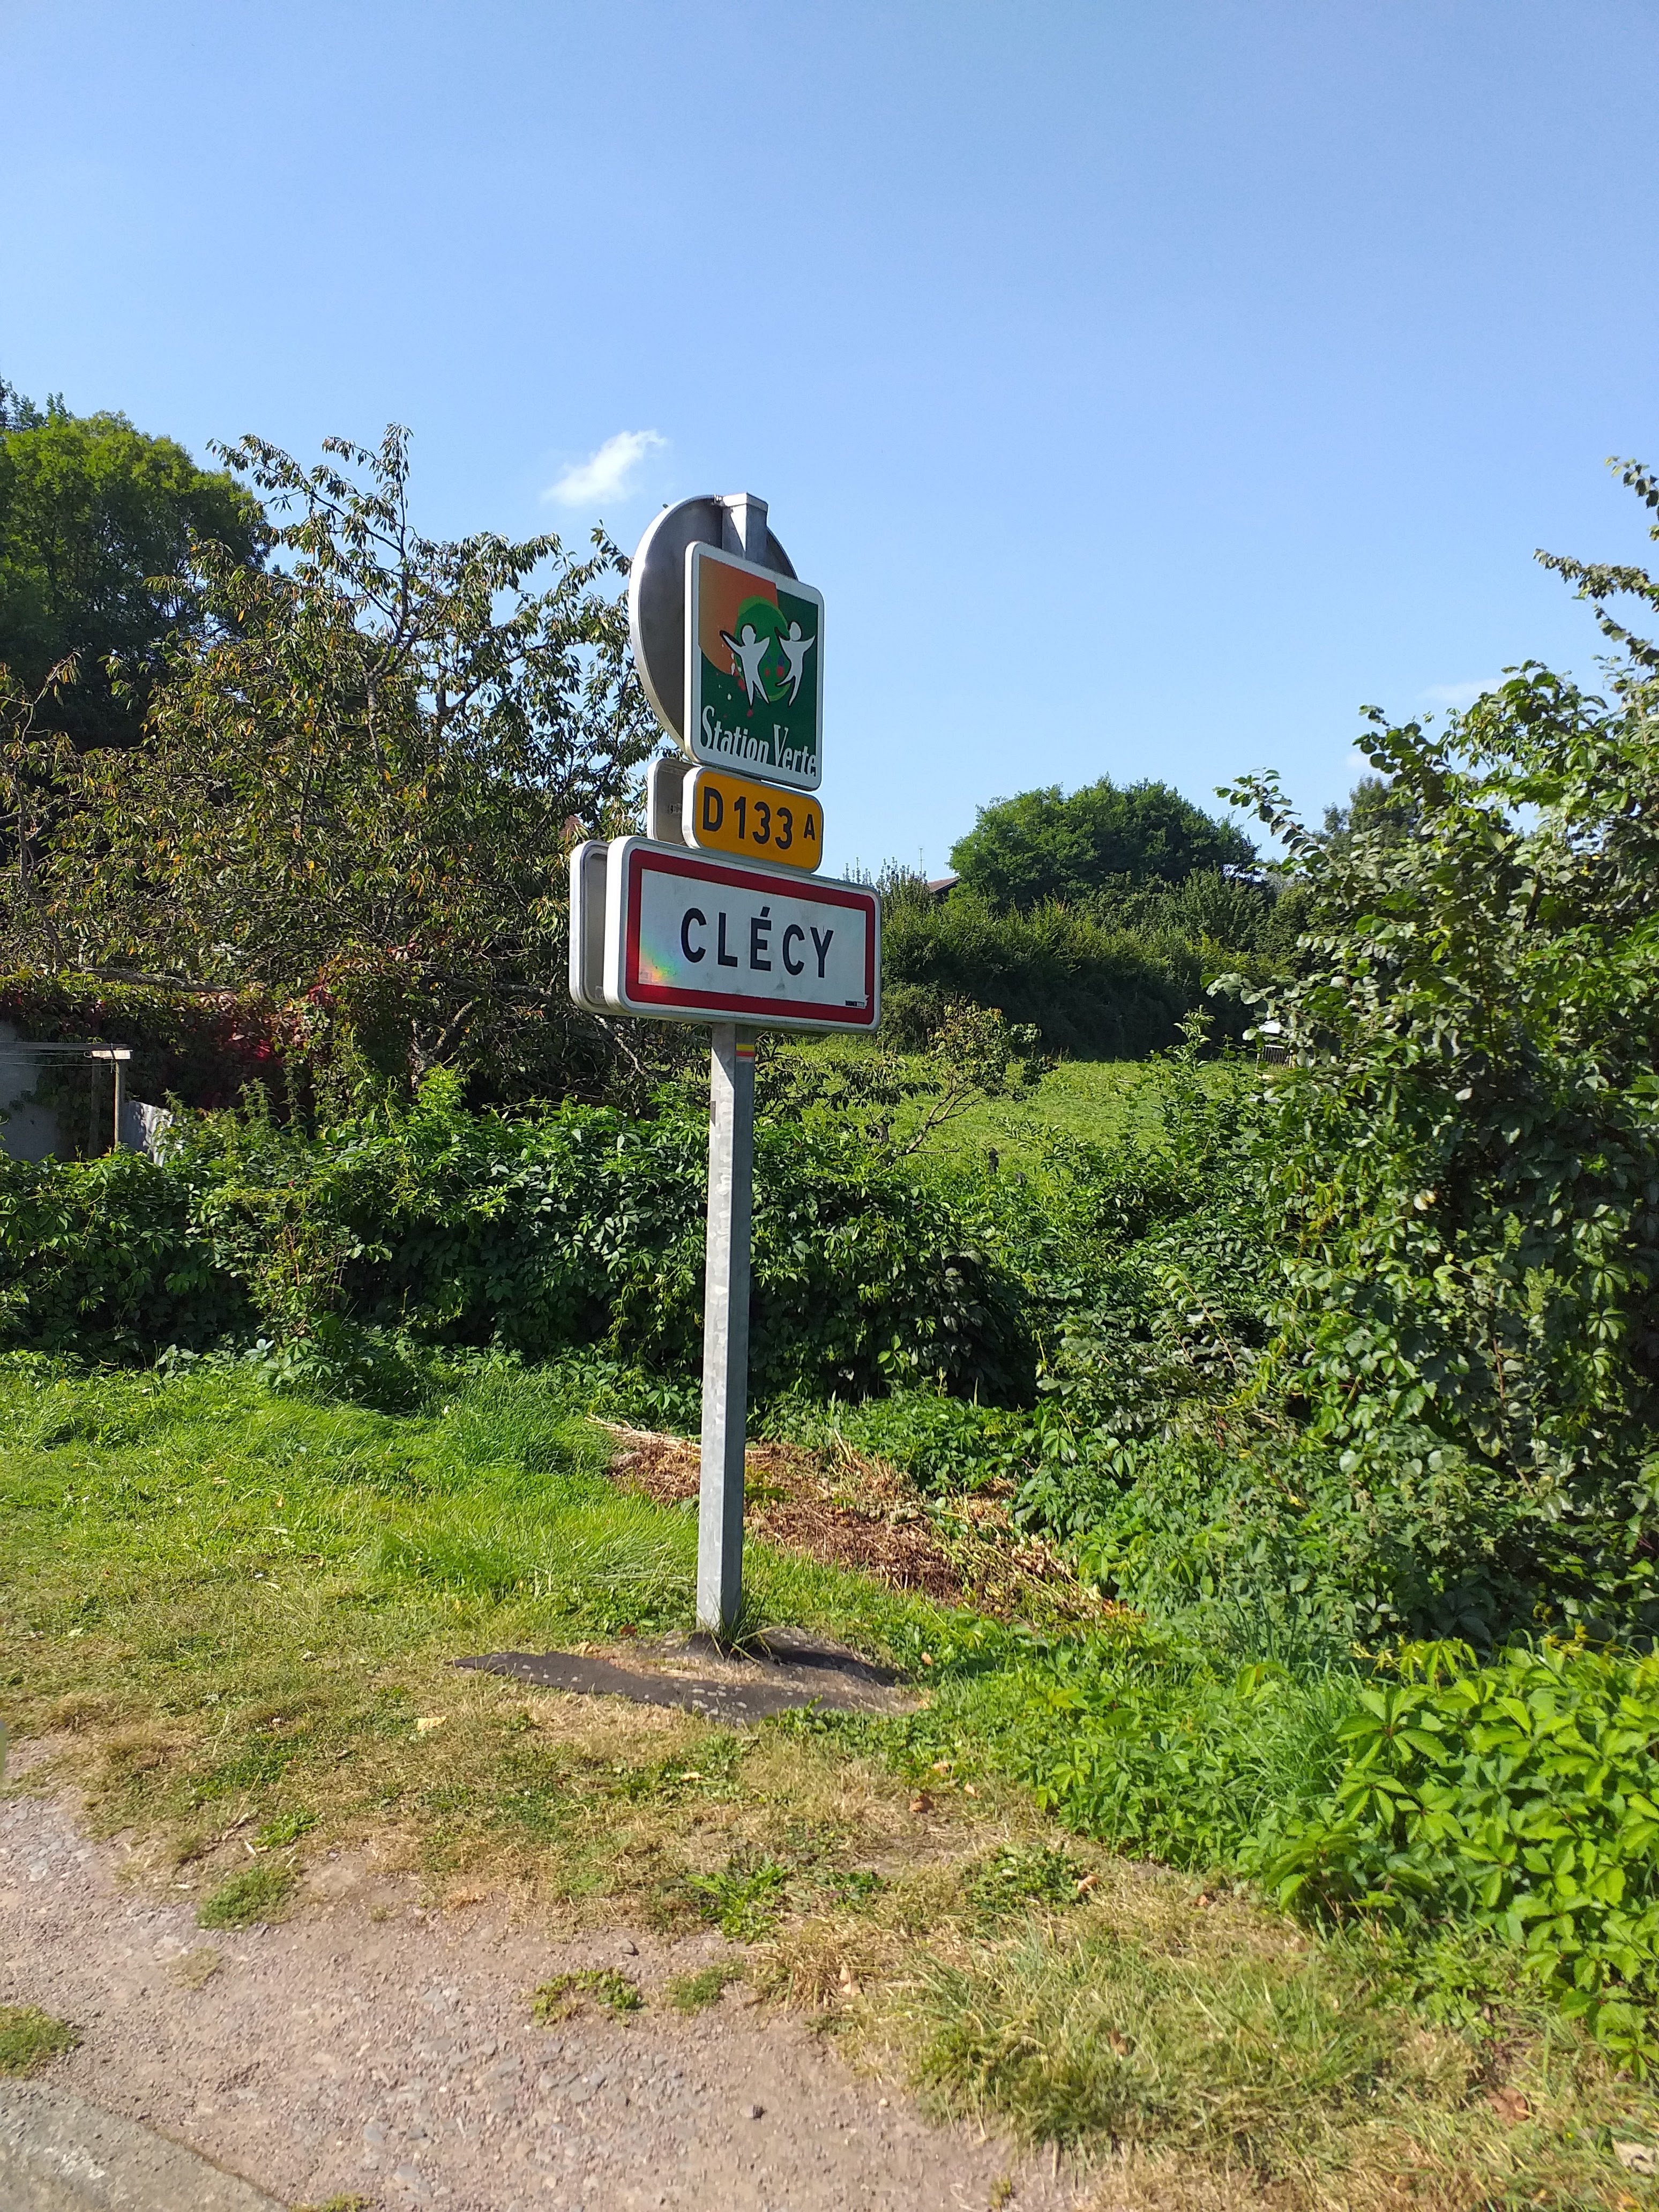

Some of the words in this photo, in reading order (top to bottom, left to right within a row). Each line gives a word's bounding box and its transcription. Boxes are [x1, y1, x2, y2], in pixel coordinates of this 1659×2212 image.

[701, 705, 769, 765] Station
[773, 723, 817, 778] Verte
[681, 906, 834, 978] CLÉCY
